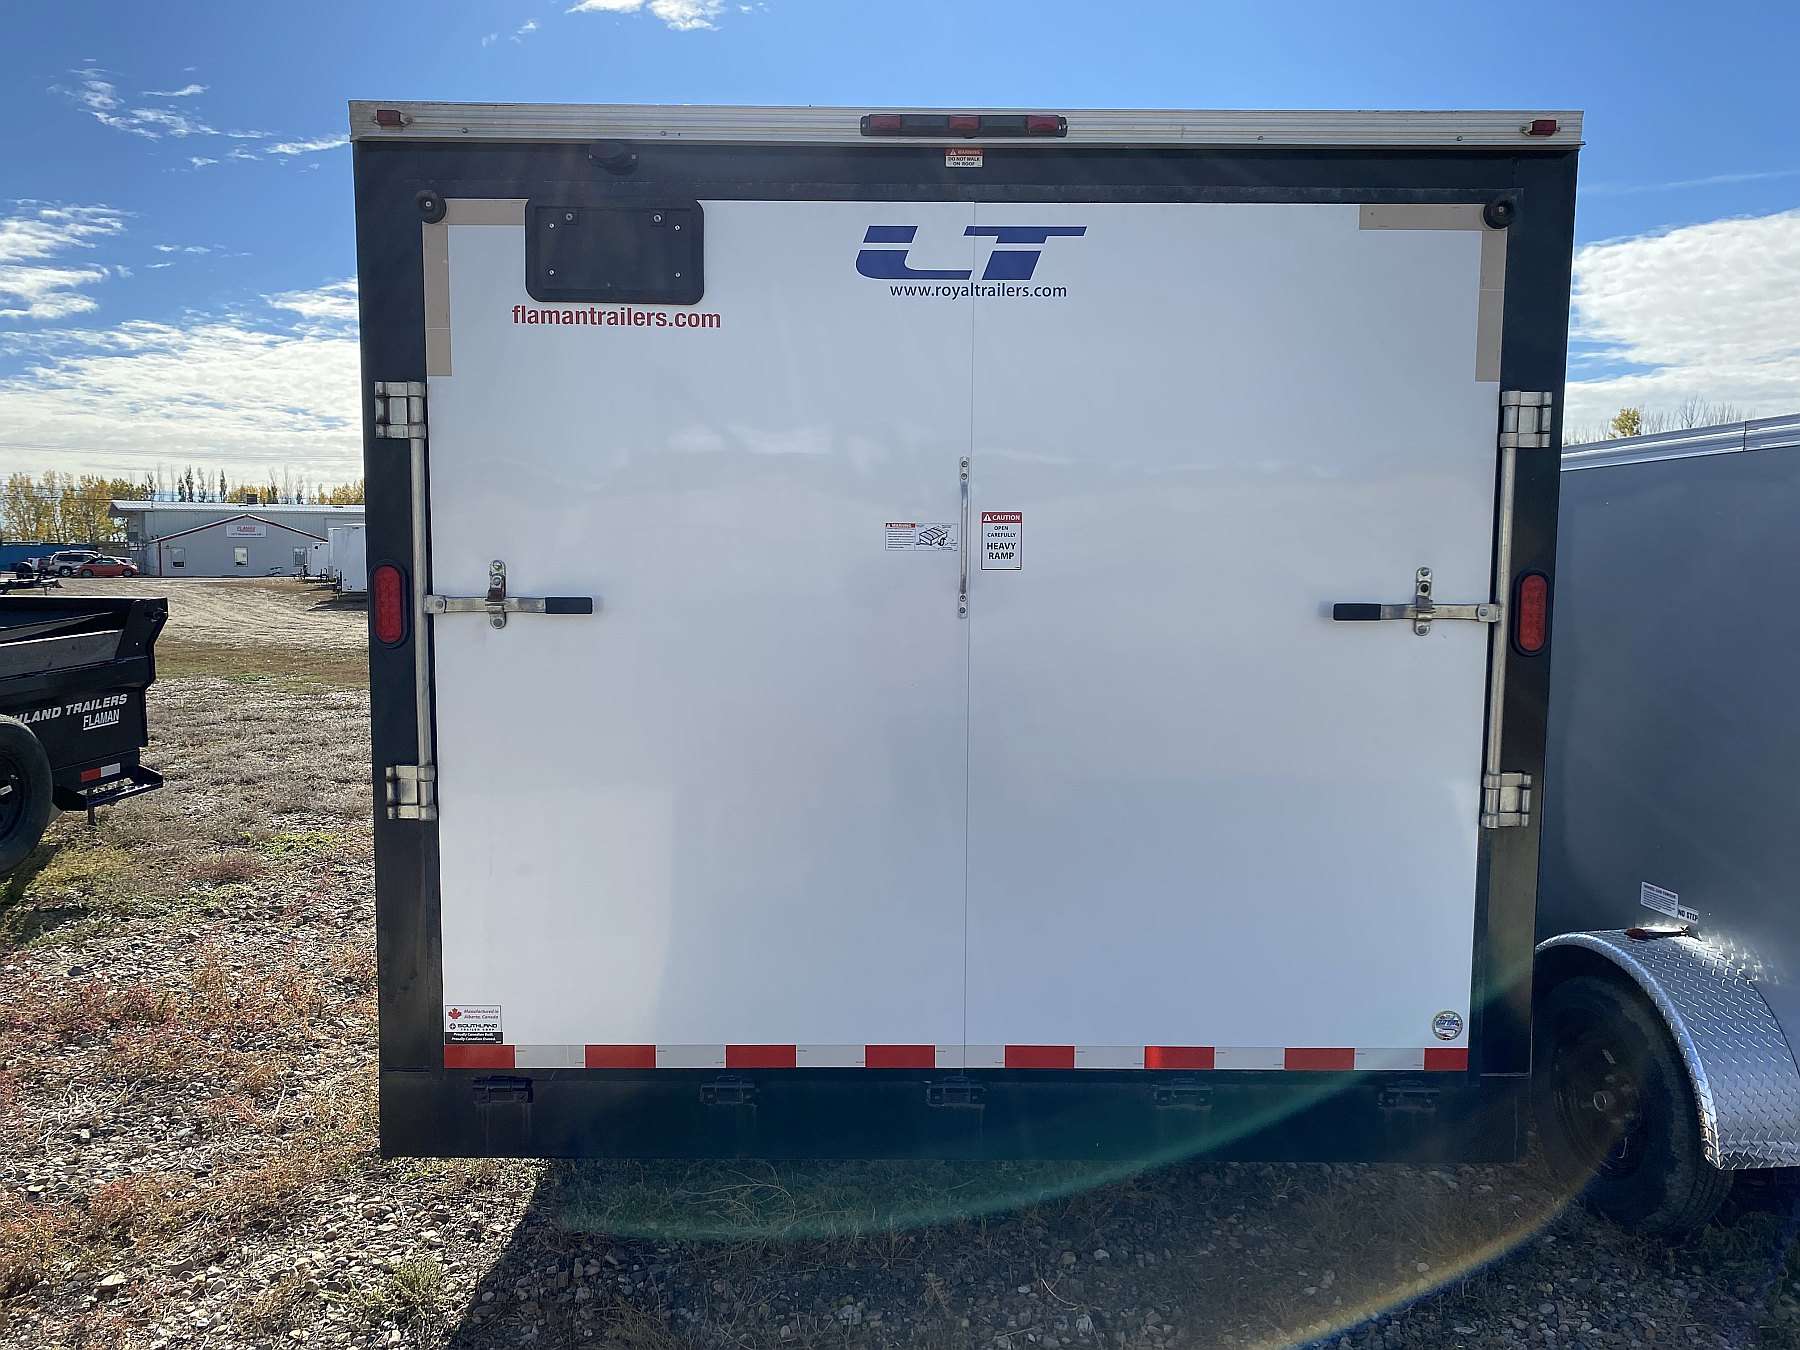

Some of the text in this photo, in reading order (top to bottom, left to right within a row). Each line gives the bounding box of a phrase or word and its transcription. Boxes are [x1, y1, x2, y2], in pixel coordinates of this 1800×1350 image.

[890, 282, 1067, 300] www.royaltrailers.com
[512, 305, 720, 328] flamantrailers.com
[987, 542, 1017, 550] HEAVY
[66, 694, 128, 716] TRAILERS
[83, 709, 120, 728] FLAMAN
[1686, 911, 1698, 921] STEP
